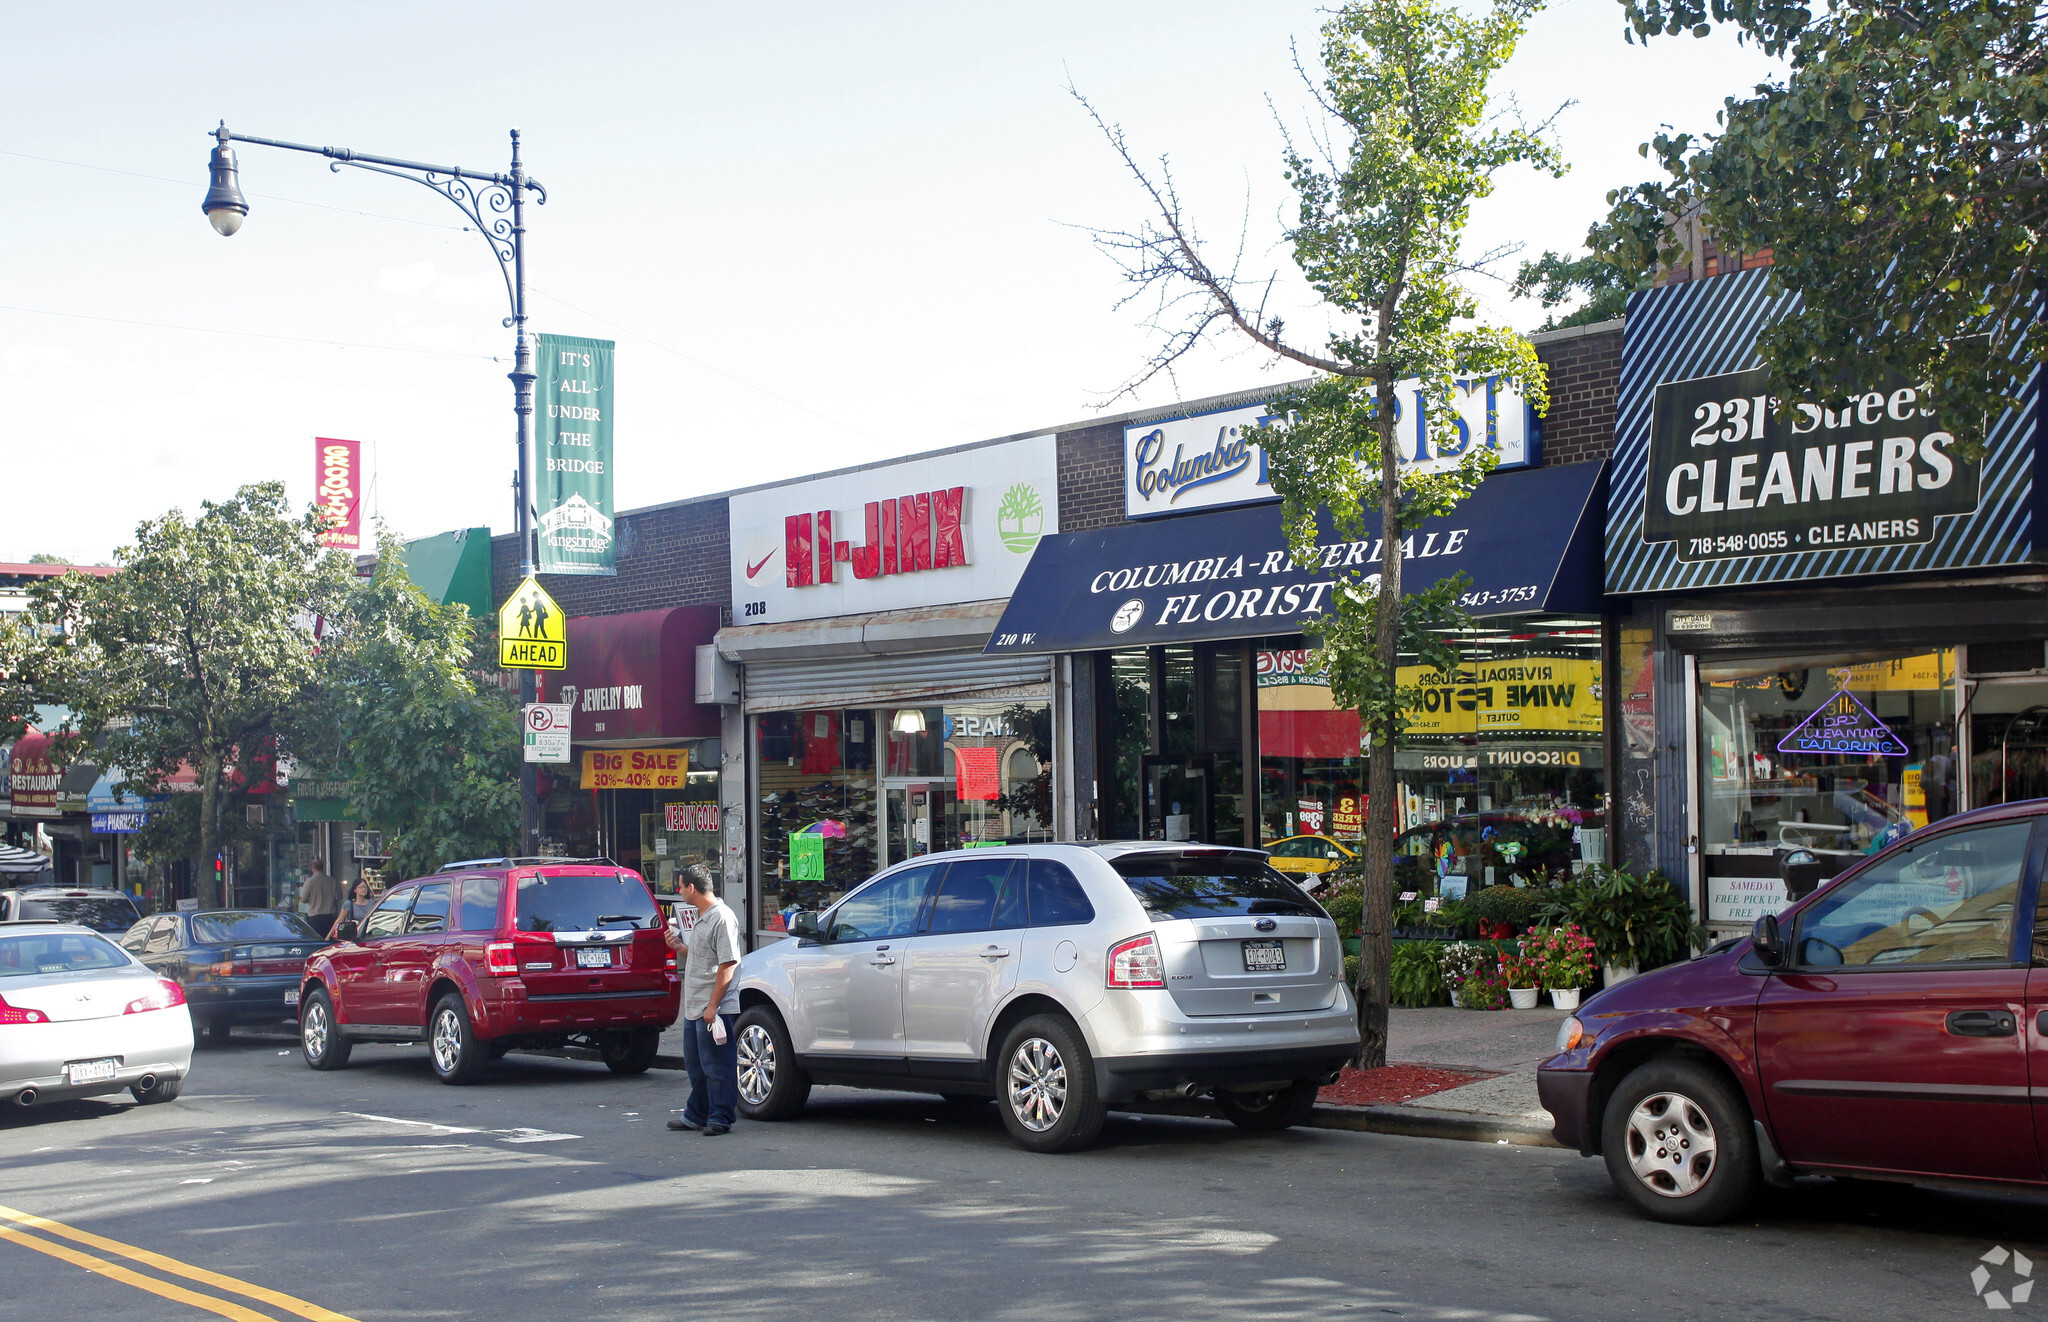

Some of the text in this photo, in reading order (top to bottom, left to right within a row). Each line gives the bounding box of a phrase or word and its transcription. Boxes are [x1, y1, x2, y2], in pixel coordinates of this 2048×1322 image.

[561, 352, 591, 368] IT'S
[560, 379, 591, 394] ALL
[548, 404, 602, 421] UNDER
[560, 432, 591, 446] THE
[546, 457, 605, 474] BRIDGE
[1665, 431, 1955, 516] CLEANERS
[785, 486, 971, 588] HI-JINX
[1808, 518, 1920, 546] CLEANERS
[1155, 580, 1337, 626] FLORIST
[1459, 585, 1538, 607] 543-3753
[745, 601, 767, 617] 208
[996, 633, 1018, 646] 210
[509, 645, 557, 662] AHEAD
[581, 685, 643, 712] JEWELRY BOX
[1827, 703, 1836, 716] 3
[1824, 713, 1862, 727] DRY
[1804, 723, 1886, 739] CLEANING
[1797, 738, 1893, 753] TAILORING
[593, 751, 678, 770] BIG SALE
[12, 774, 62, 791] RESTAURANT
[657, 775, 678, 786] OFF
[664, 805, 720, 832] WE BUY GOLD
[792, 837, 821, 852] SALE
[1730, 881, 1775, 891] SAMEDAY
[1715, 895, 1781, 905] FREE PICK UP
[1729, 908, 1753, 917] FREE
